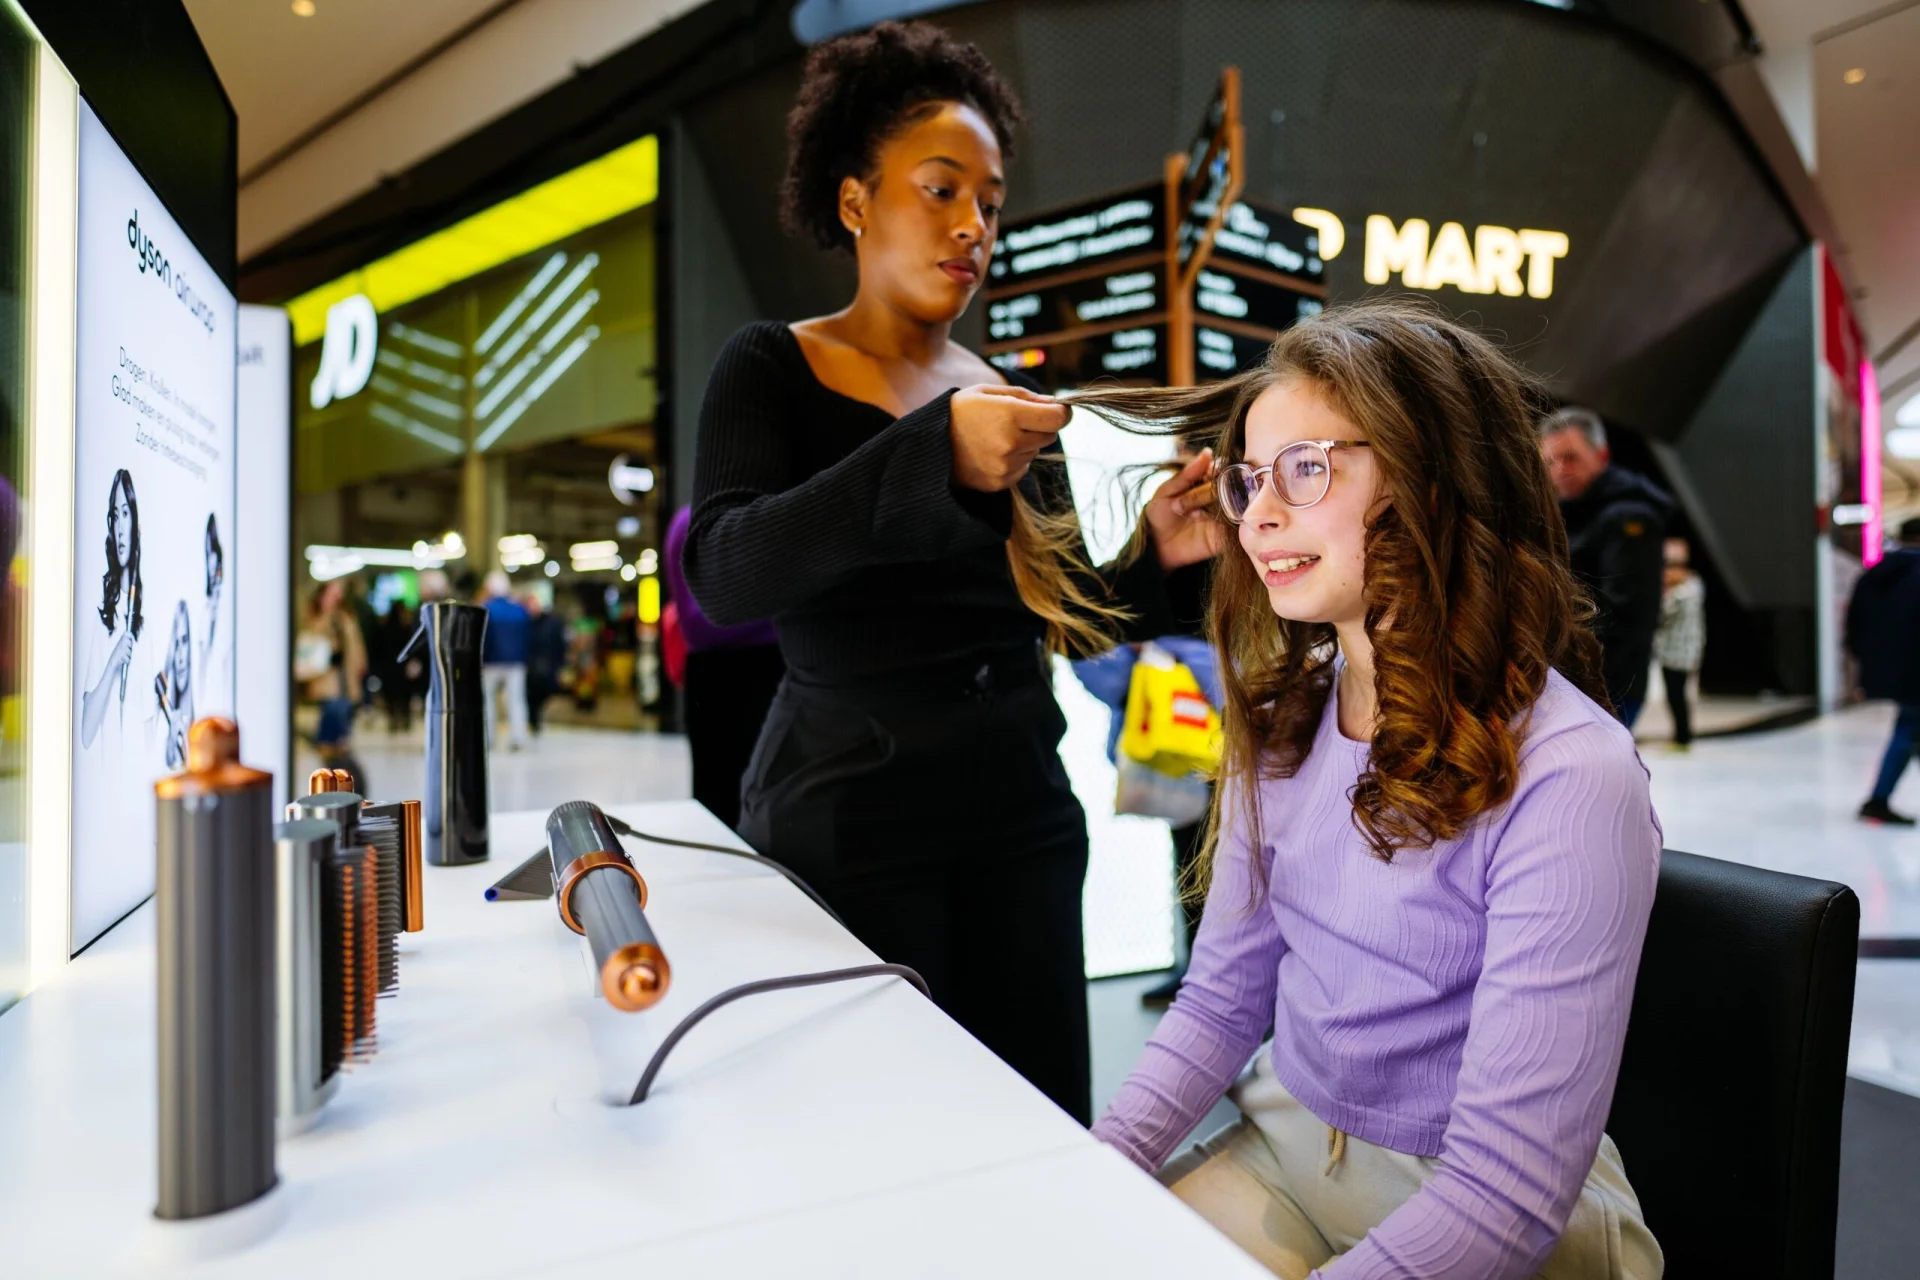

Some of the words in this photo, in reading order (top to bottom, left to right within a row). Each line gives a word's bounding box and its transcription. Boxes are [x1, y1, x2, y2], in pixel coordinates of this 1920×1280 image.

[127, 207, 172, 289] dyson
[1364, 214, 1569, 299] MART
[111, 374, 131, 405] Glad
[310, 294, 378, 409] JD
